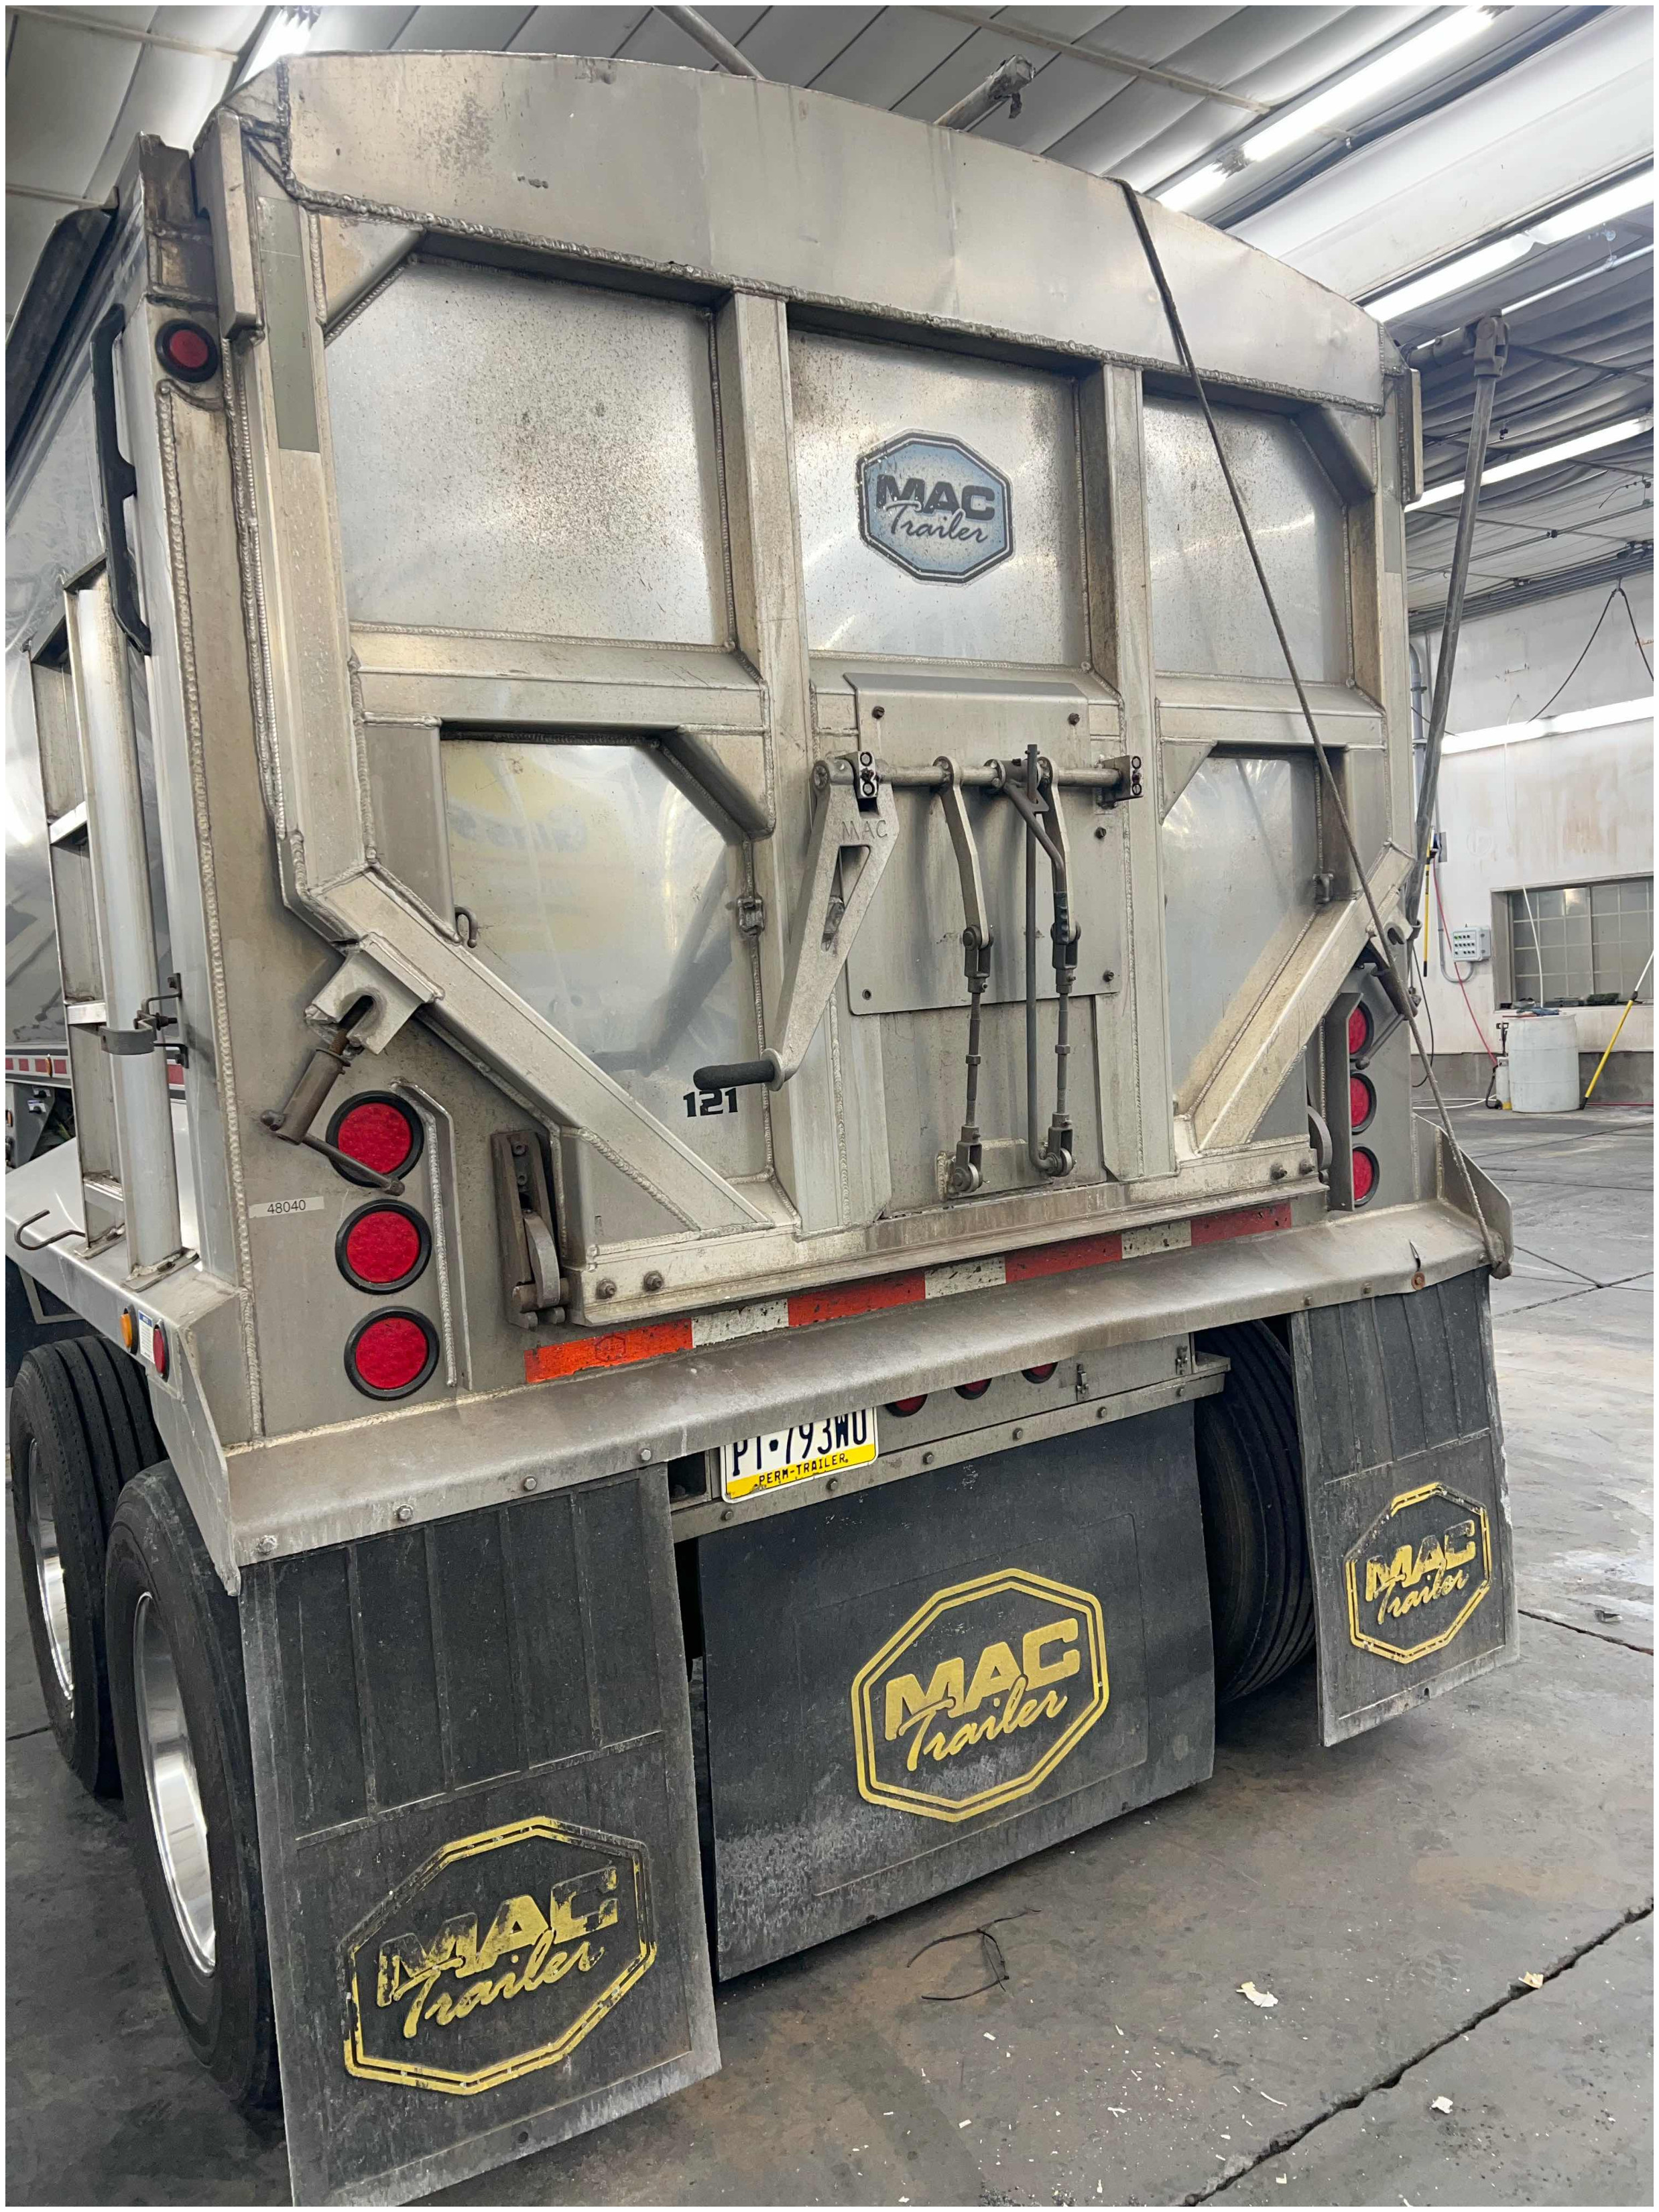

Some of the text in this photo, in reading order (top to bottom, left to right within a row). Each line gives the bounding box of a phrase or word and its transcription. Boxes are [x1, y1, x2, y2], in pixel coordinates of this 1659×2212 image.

[876, 474, 995, 521] MAC
[886, 503, 988, 543] Trailer
[842, 820, 887, 841] MAC
[683, 1087, 738, 1118] 121
[267, 1199, 306, 1214] 48040
[1365, 1520, 1476, 1601] MAC
[1373, 1558, 1469, 1625] Trailer
[885, 1617, 1081, 1741] MAC
[898, 1676, 1068, 1772] Trailer
[377, 1866, 619, 2008] MAC
[393, 1930, 605, 2038] Trailer
